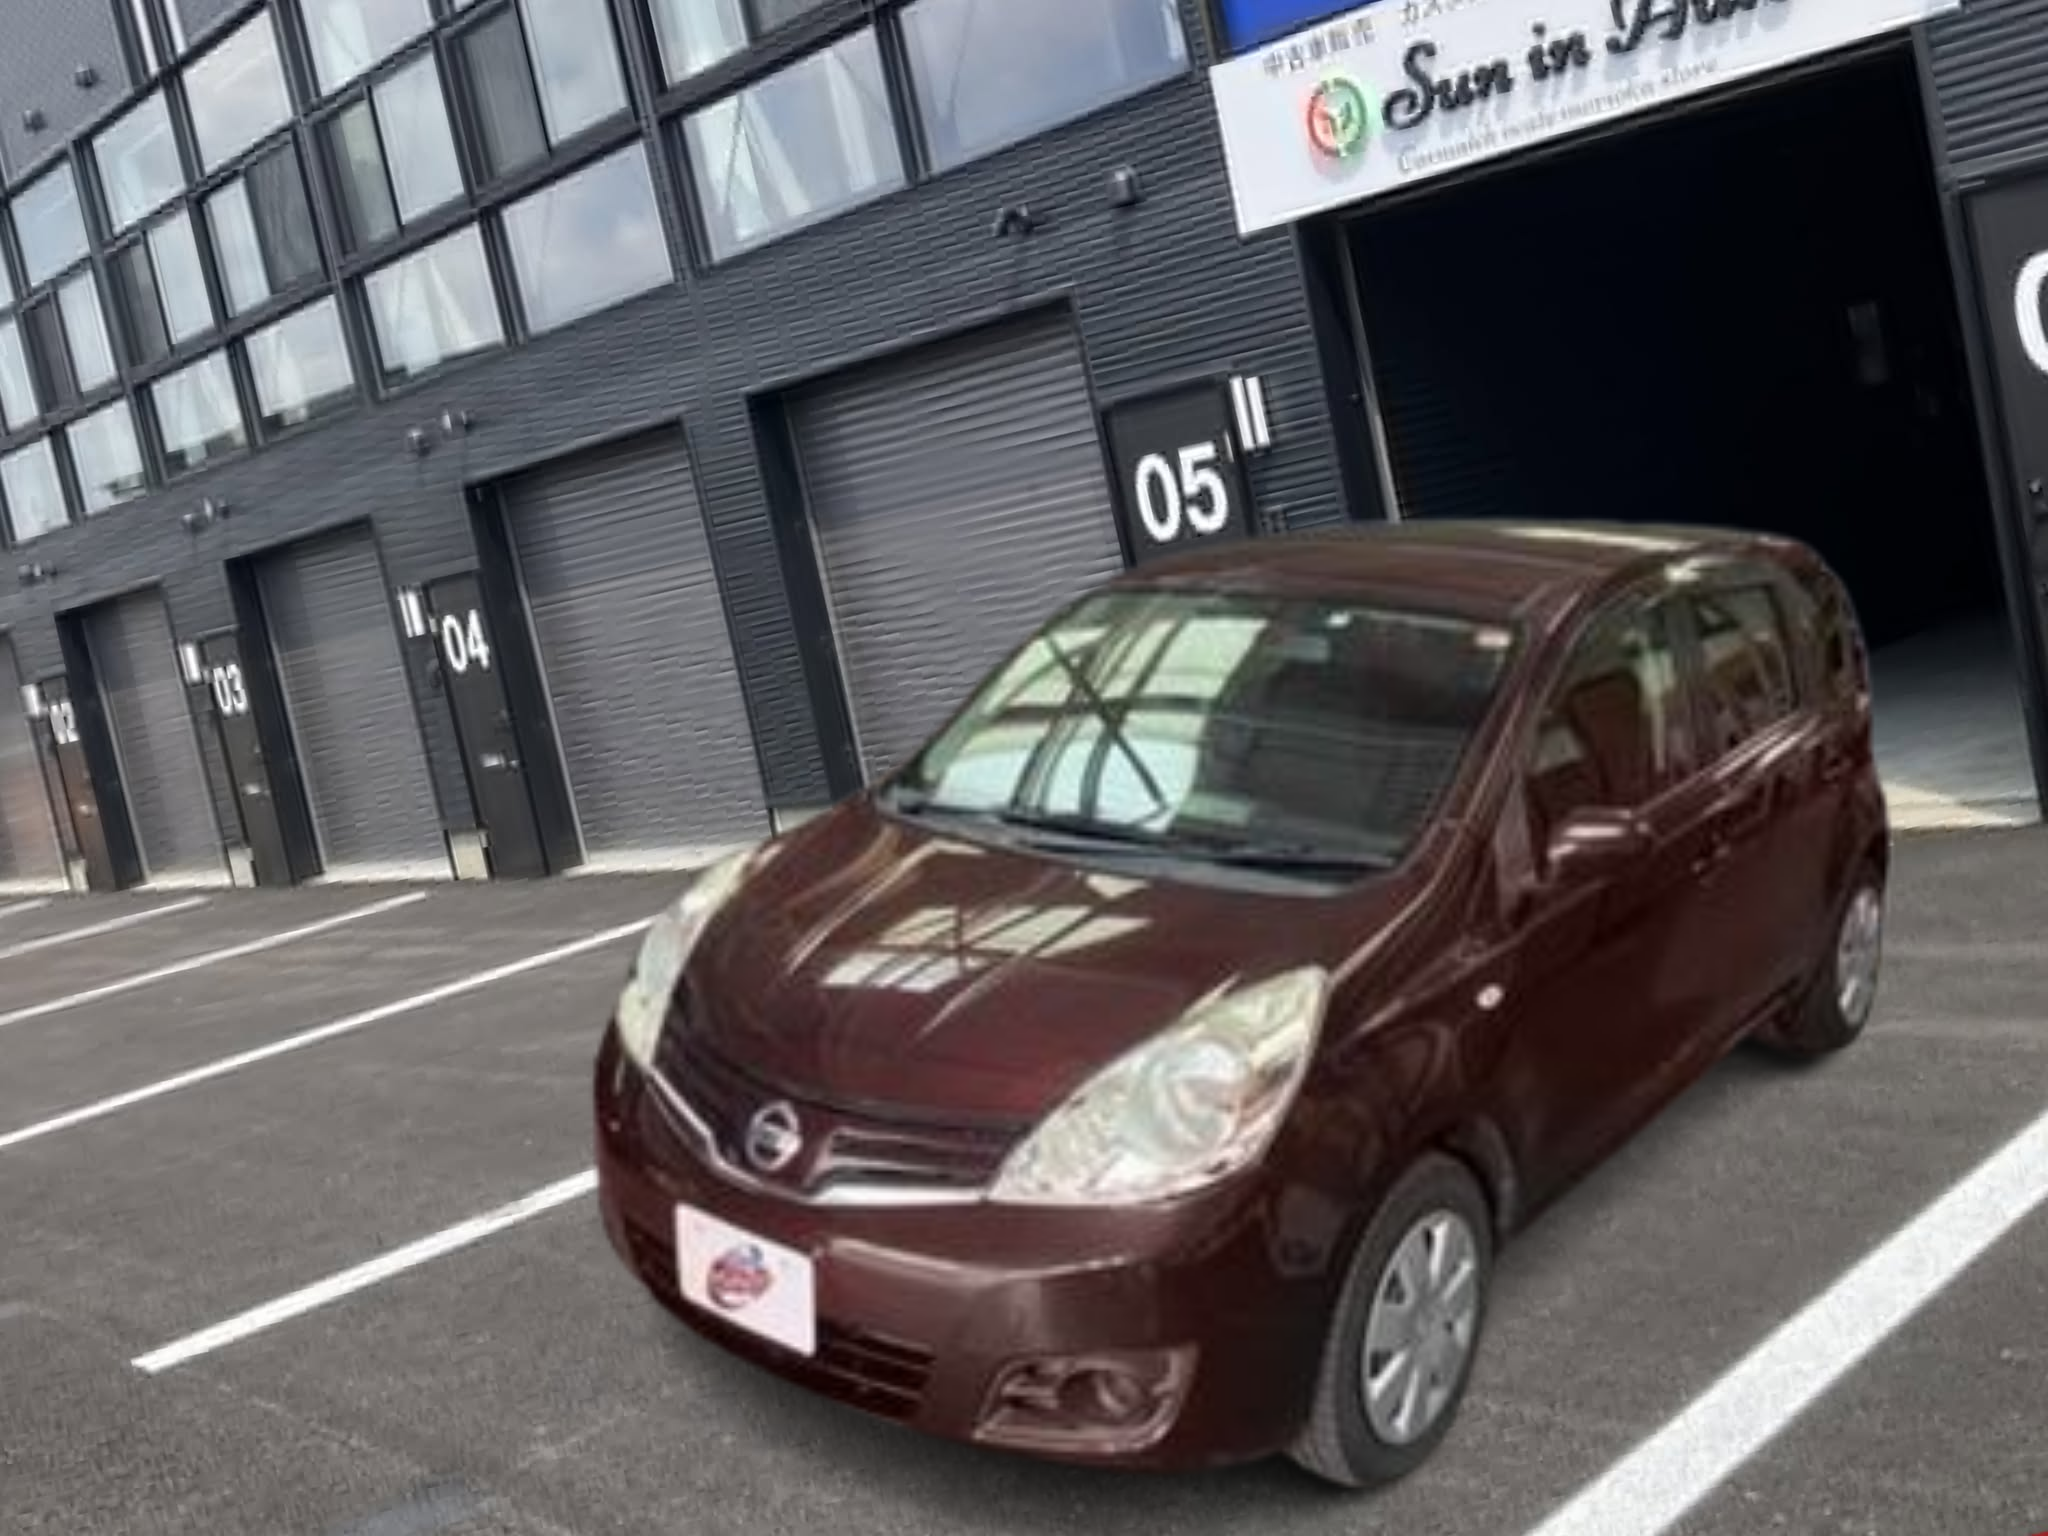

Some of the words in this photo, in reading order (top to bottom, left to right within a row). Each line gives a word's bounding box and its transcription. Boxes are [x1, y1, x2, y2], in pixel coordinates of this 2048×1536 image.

[1382, 40, 1515, 131] Sun
[1527, 20, 1591, 81] in
[1136, 440, 1229, 543] 05
[442, 609, 490, 673] 04
[213, 664, 249, 715] 03
